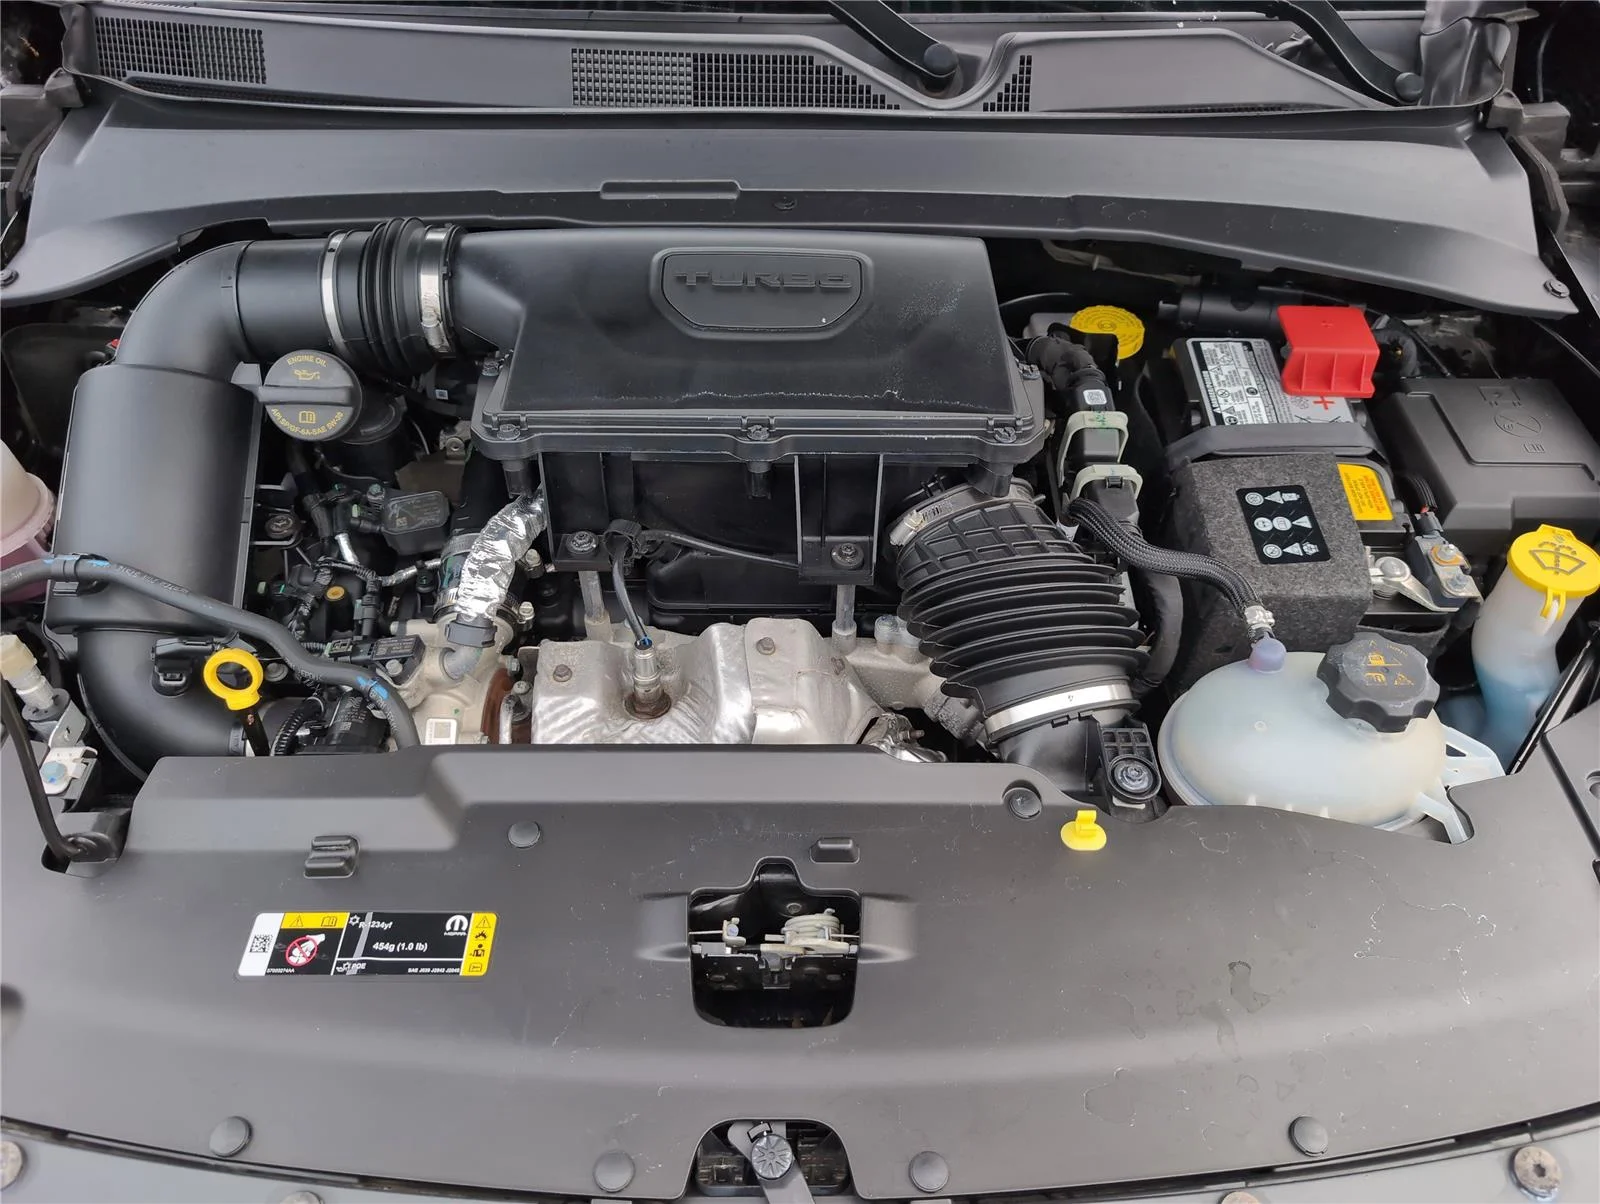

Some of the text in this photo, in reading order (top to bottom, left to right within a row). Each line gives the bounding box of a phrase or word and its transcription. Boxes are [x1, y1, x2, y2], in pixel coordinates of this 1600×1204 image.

[673, 272, 853, 289] TURBO
[287, 355, 328, 368] ENGINE OIL
[372, 942, 428, 953] 454g (1.0 lb)
